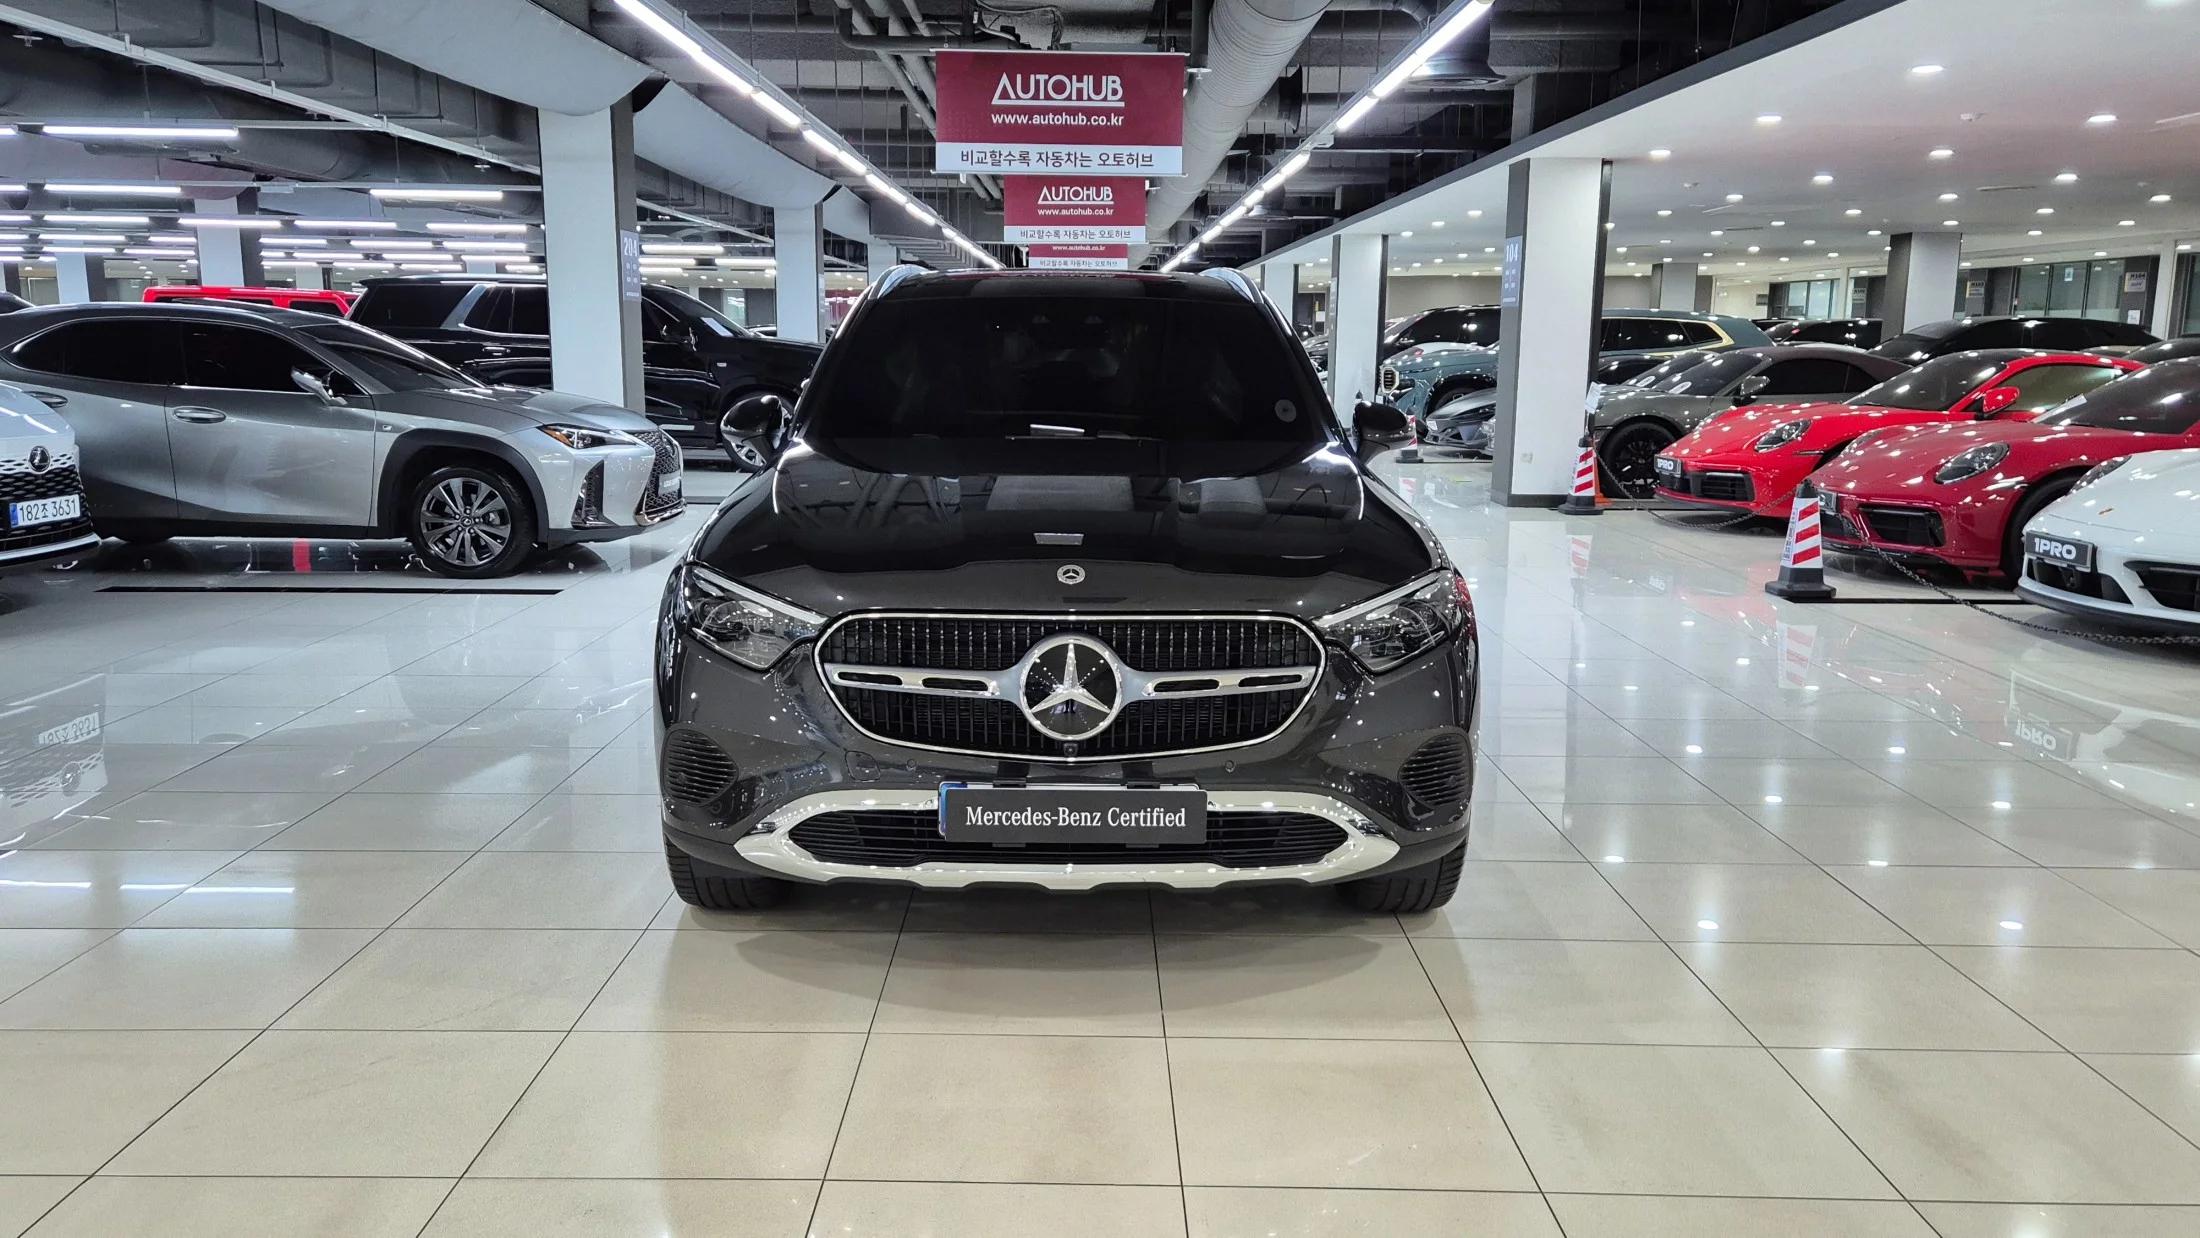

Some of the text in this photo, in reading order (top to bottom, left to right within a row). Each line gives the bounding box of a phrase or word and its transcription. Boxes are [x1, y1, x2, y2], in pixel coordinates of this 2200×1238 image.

[991, 72, 1125, 107] AUTOHUB
[991, 112, 1124, 126] www.autohub.co.kr
[961, 150, 1154, 168] 비교할수록 자동차는 오토허브
[1037, 185, 1114, 205] AUTOHUB
[1037, 207, 1114, 216] www.autohub.co.kr
[1020, 229, 1131, 239] 비교할수록 자동차는 오토허브
[623, 236, 638, 256] 204
[1506, 243, 1519, 262] 104
[20, 499, 77, 522] 182조 3631
[2034, 537, 2077, 560] 1PRO
[966, 806, 1187, 828] Mercedes-Benz Certified
